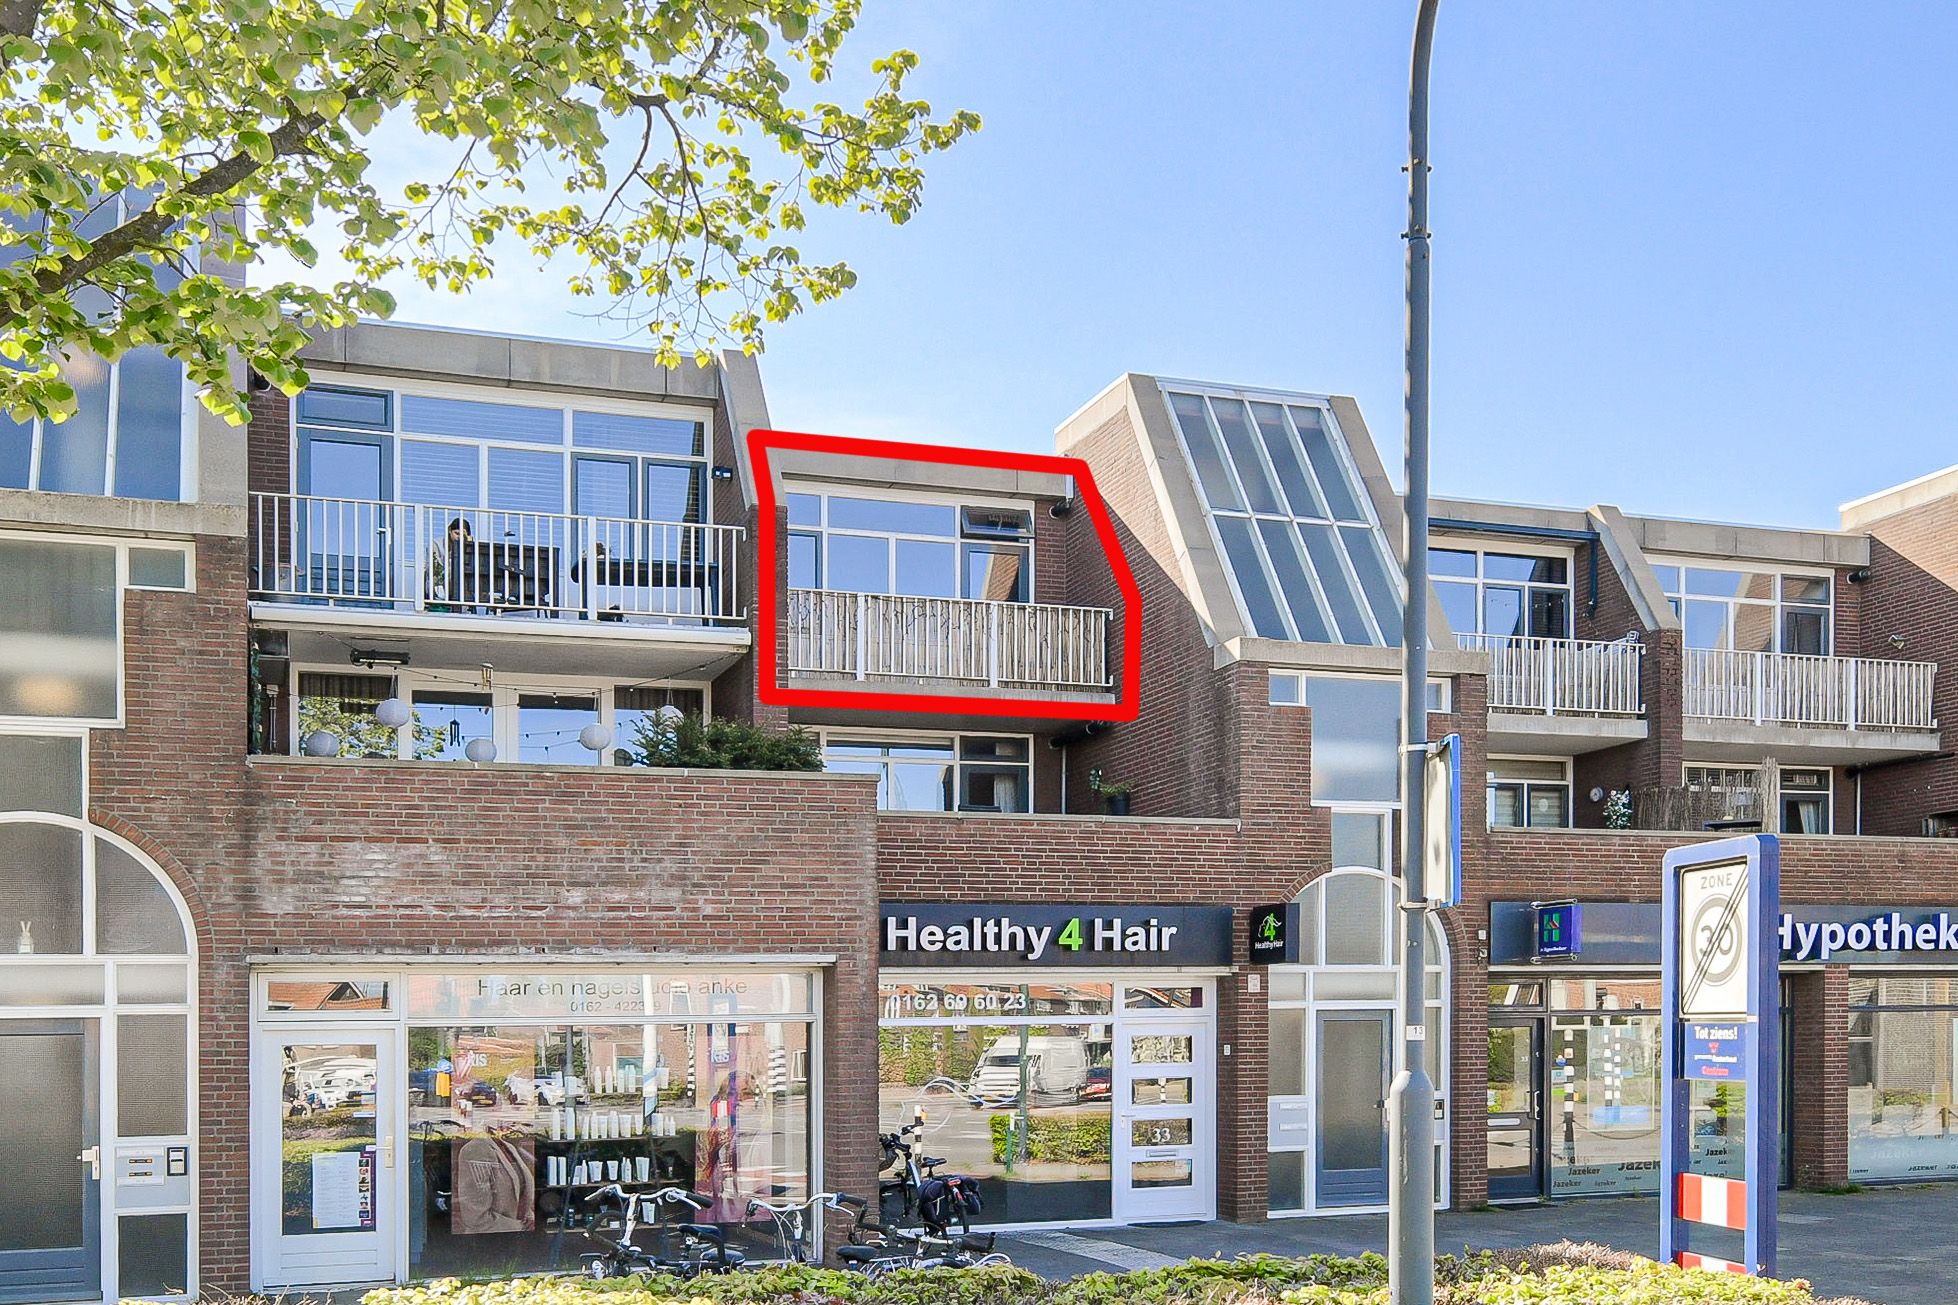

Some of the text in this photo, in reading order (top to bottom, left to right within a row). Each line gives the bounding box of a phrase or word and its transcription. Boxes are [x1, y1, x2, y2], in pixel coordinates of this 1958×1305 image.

[1700, 873, 1733, 890] ZONE
[887, 916, 1178, 961] Healthy 4 Hair
[478, 979, 531, 996] Haar
[538, 982, 563, 996] en
[698, 978, 748, 994] anke
[570, 1001, 602, 1012] 0162
[614, 1000, 661, 1012] 42239
[890, 993, 938, 1011] 0162
[1004, 993, 1028, 1010] 23
[1694, 1026, 1738, 1040] Tot ziens!
[1151, 1127, 1171, 1142] 33
[1568, 1166, 1600, 1176] Jazeker
